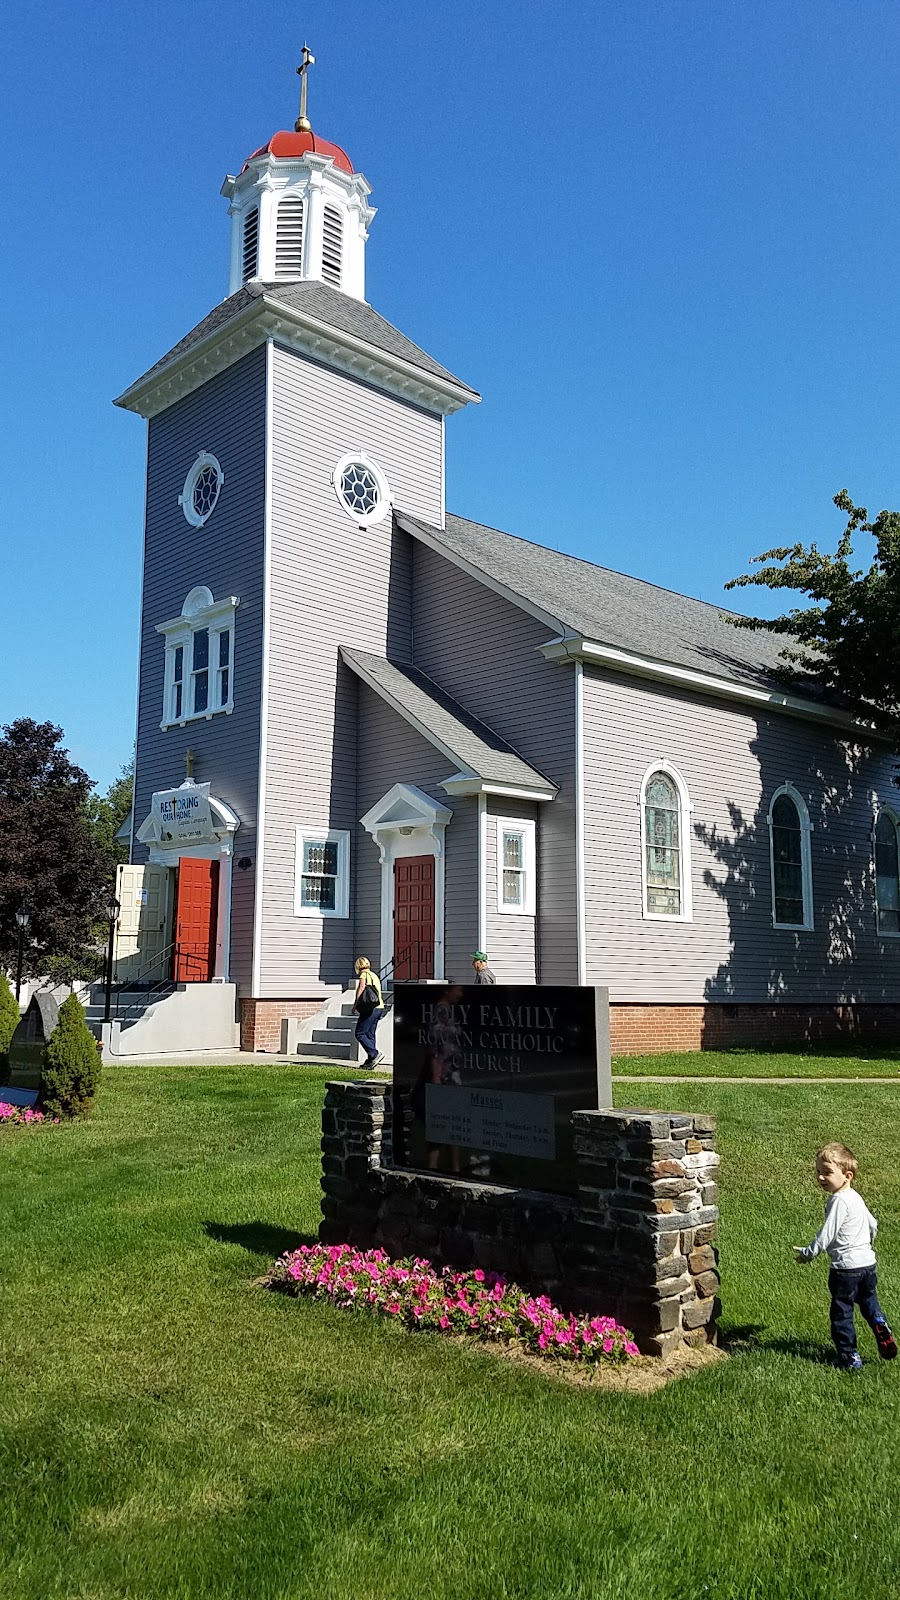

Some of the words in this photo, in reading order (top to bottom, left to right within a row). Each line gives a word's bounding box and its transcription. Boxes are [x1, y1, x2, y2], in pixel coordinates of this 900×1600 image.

[162, 812, 174, 822] OUR
[176, 809, 191, 821] HOME
[421, 1003, 471, 1025] HOLY
[479, 1004, 558, 1029] FAMILY
[418, 1028, 473, 1047] ROMAN
[479, 1031, 564, 1053] CATHOLIC
[452, 1052, 521, 1073] CHURCH
[470, 1093, 503, 1108] Masses
